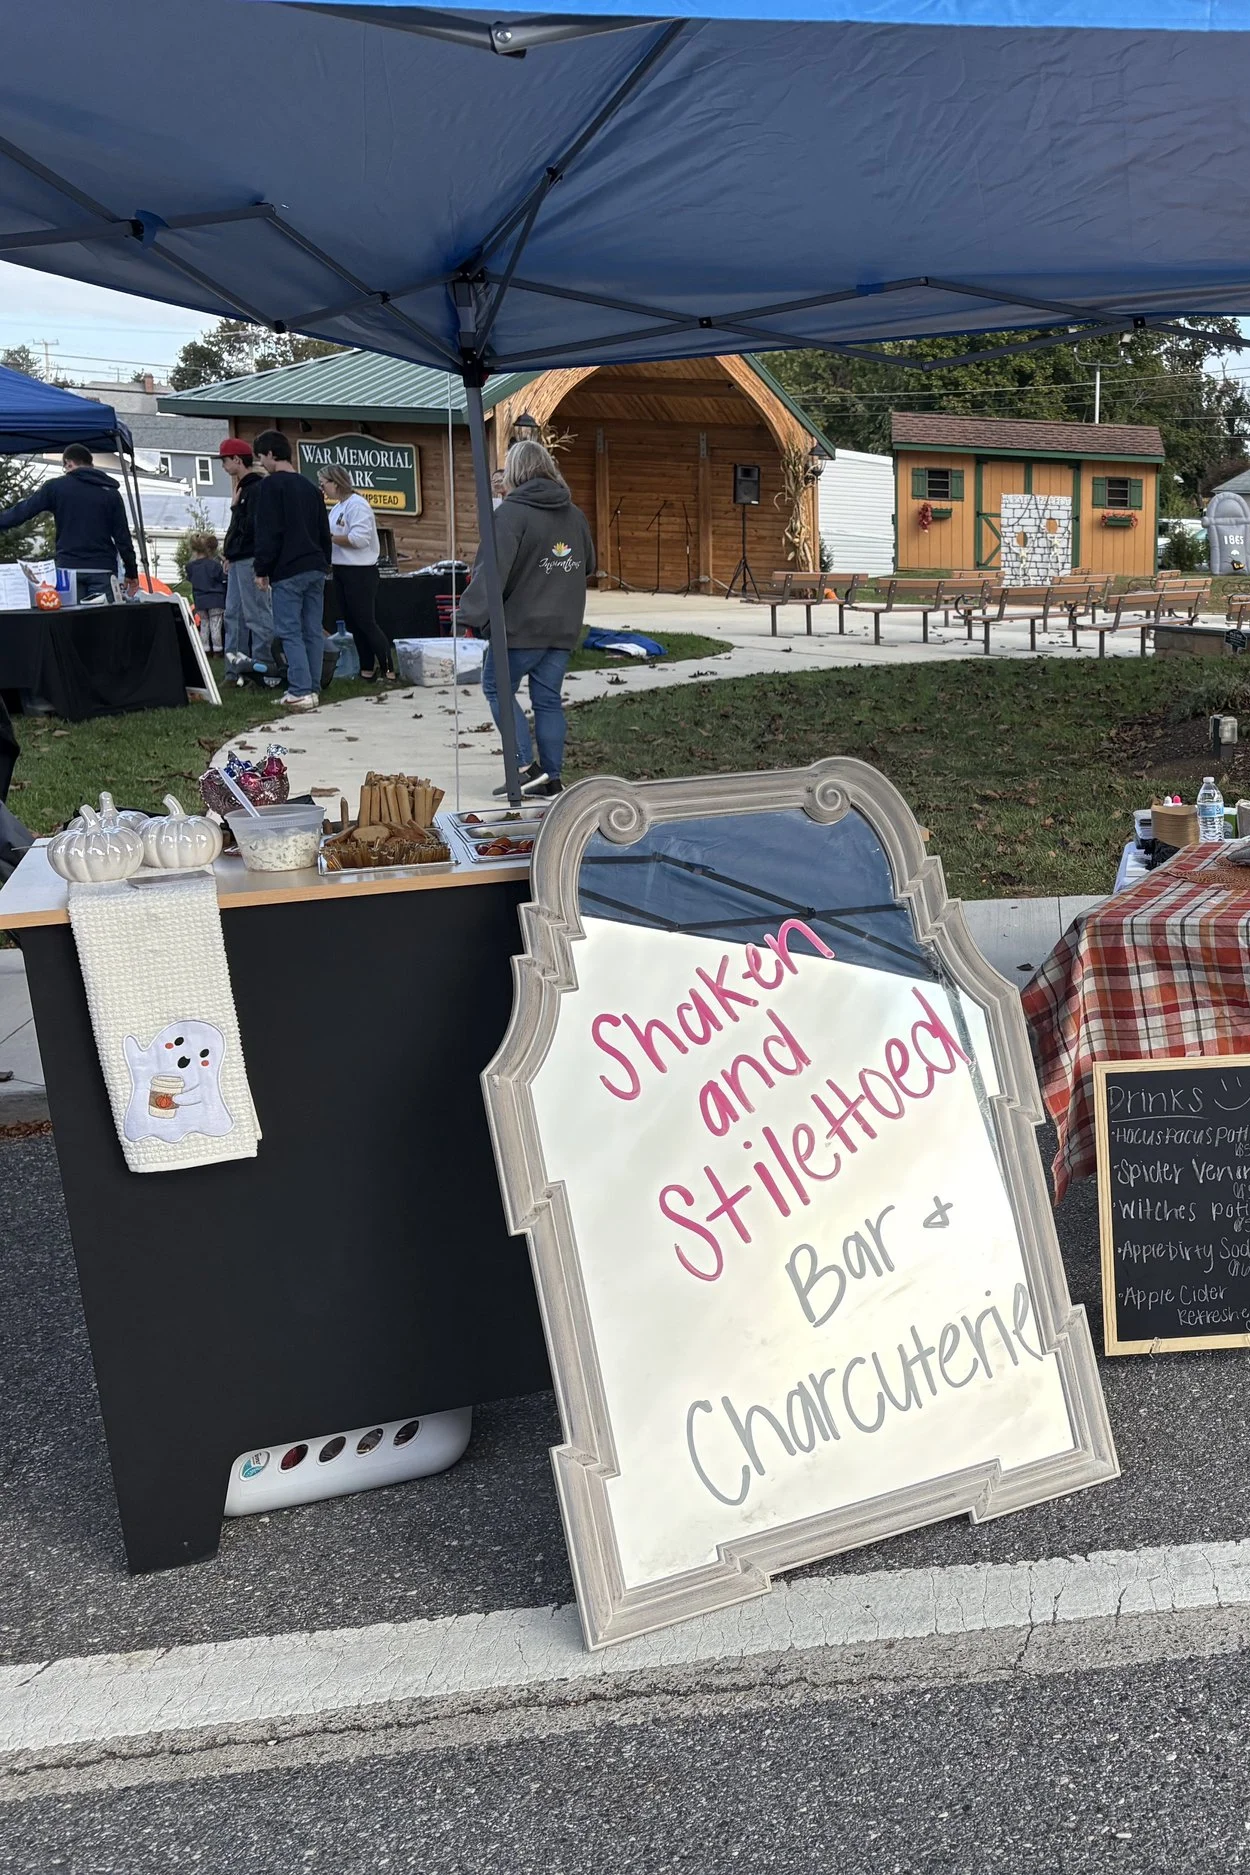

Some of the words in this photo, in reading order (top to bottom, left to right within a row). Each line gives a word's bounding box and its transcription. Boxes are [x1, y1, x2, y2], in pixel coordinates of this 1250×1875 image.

[300, 444, 333, 464] WAR
[335, 446, 413, 469] MEMORIAL
[349, 469, 375, 488] ARK
[591, 918, 836, 1101] Shaken
[699, 1009, 812, 1137] and
[1107, 1085, 1204, 1114] Drinks
[1116, 1158, 1185, 1188] Spider
[1118, 1199, 1197, 1222] Witches
[785, 1205, 895, 1328] Bar
[1123, 1285, 1175, 1310] Apple
[1179, 1284, 1229, 1306] Cider
[686, 1282, 1044, 1506] Charcuterie
